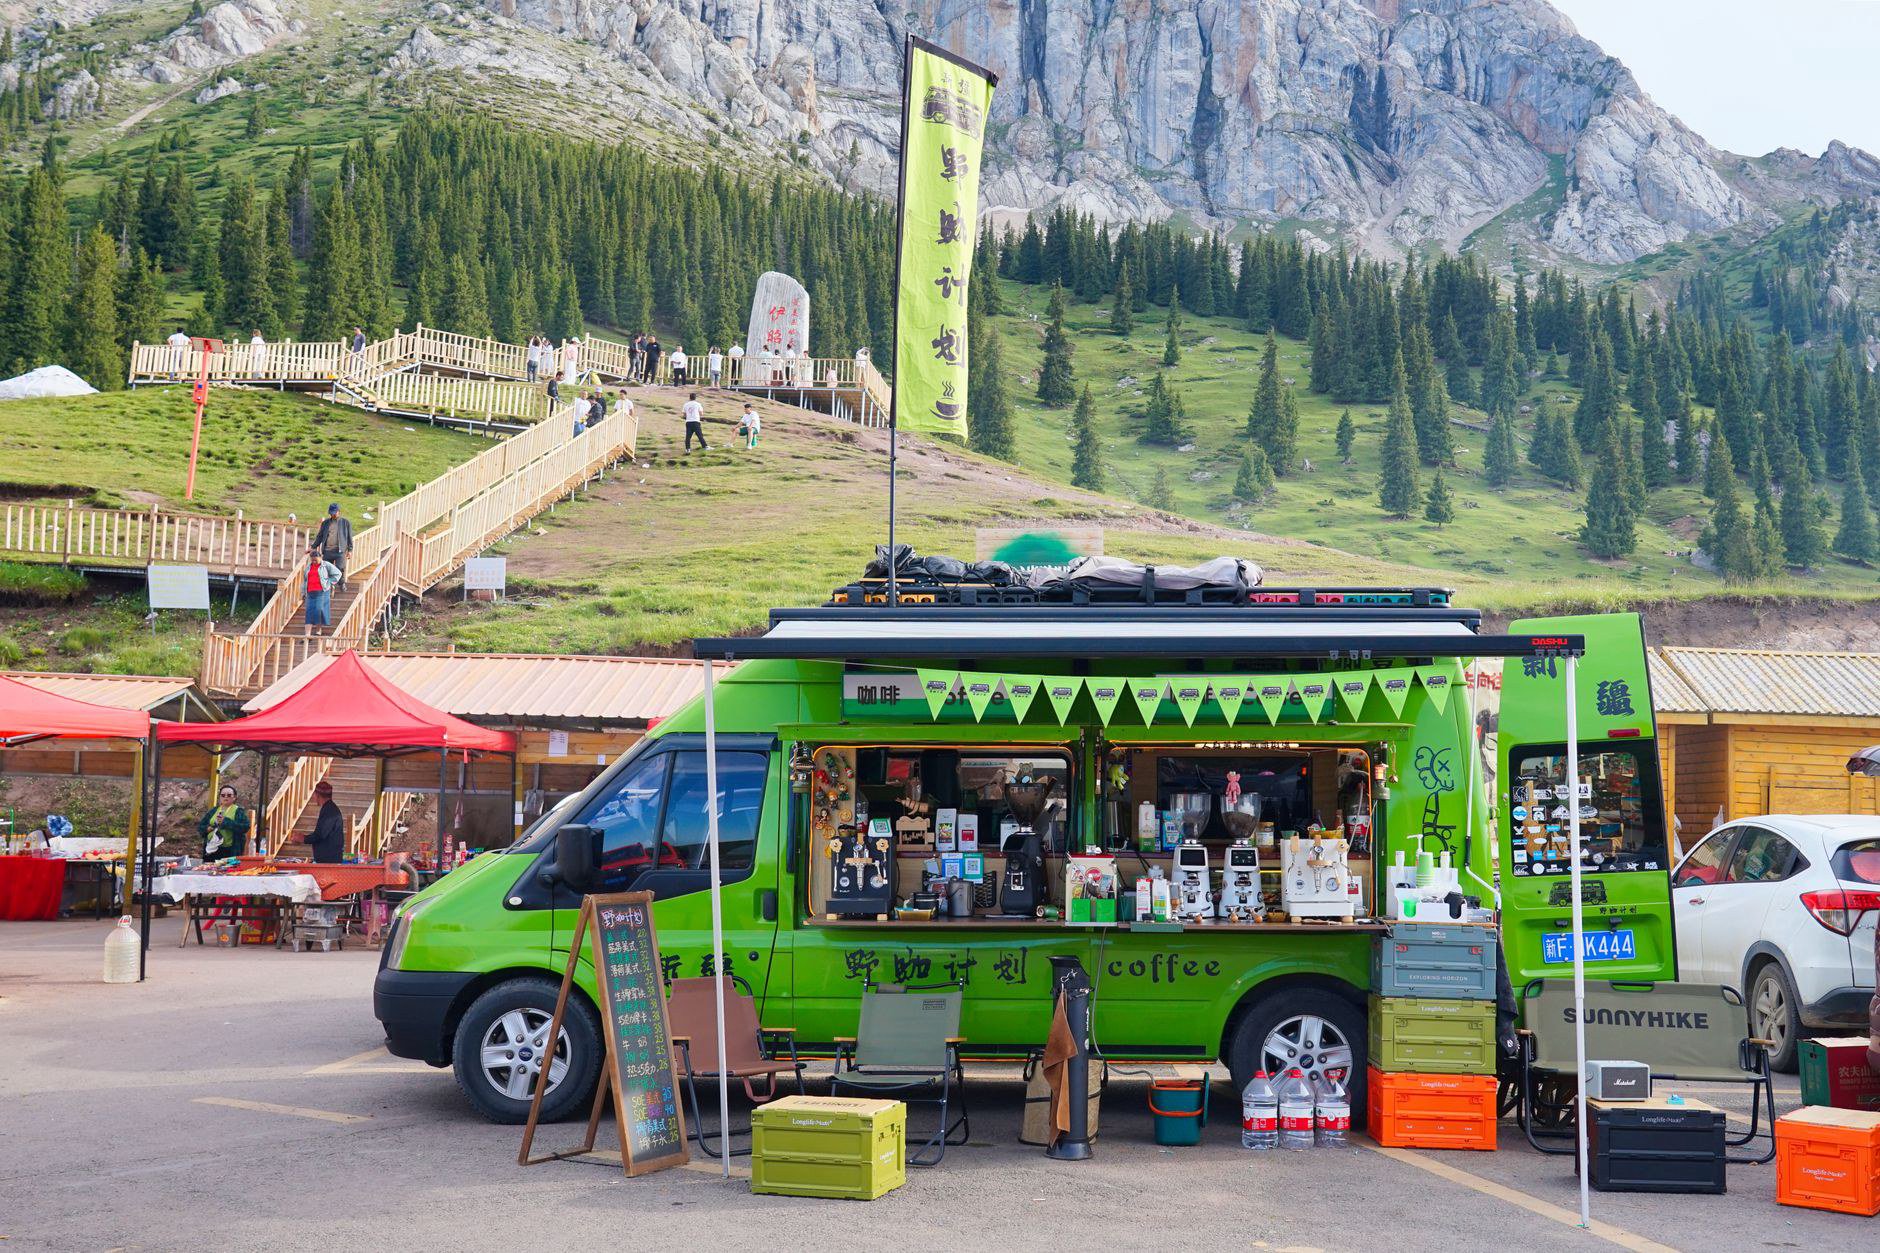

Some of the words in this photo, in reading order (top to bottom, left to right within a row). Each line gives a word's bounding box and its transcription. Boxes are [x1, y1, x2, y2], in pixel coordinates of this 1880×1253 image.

[857, 685, 900, 706] 咖啡
[601, 907, 644, 929] 野咖计划
[1545, 934, 1632, 958] 新F·K444
[844, 946, 1028, 986] 野咖计划
[1108, 953, 1221, 983] coffee
[1563, 1007, 1709, 1030] SUNNYHIKE
